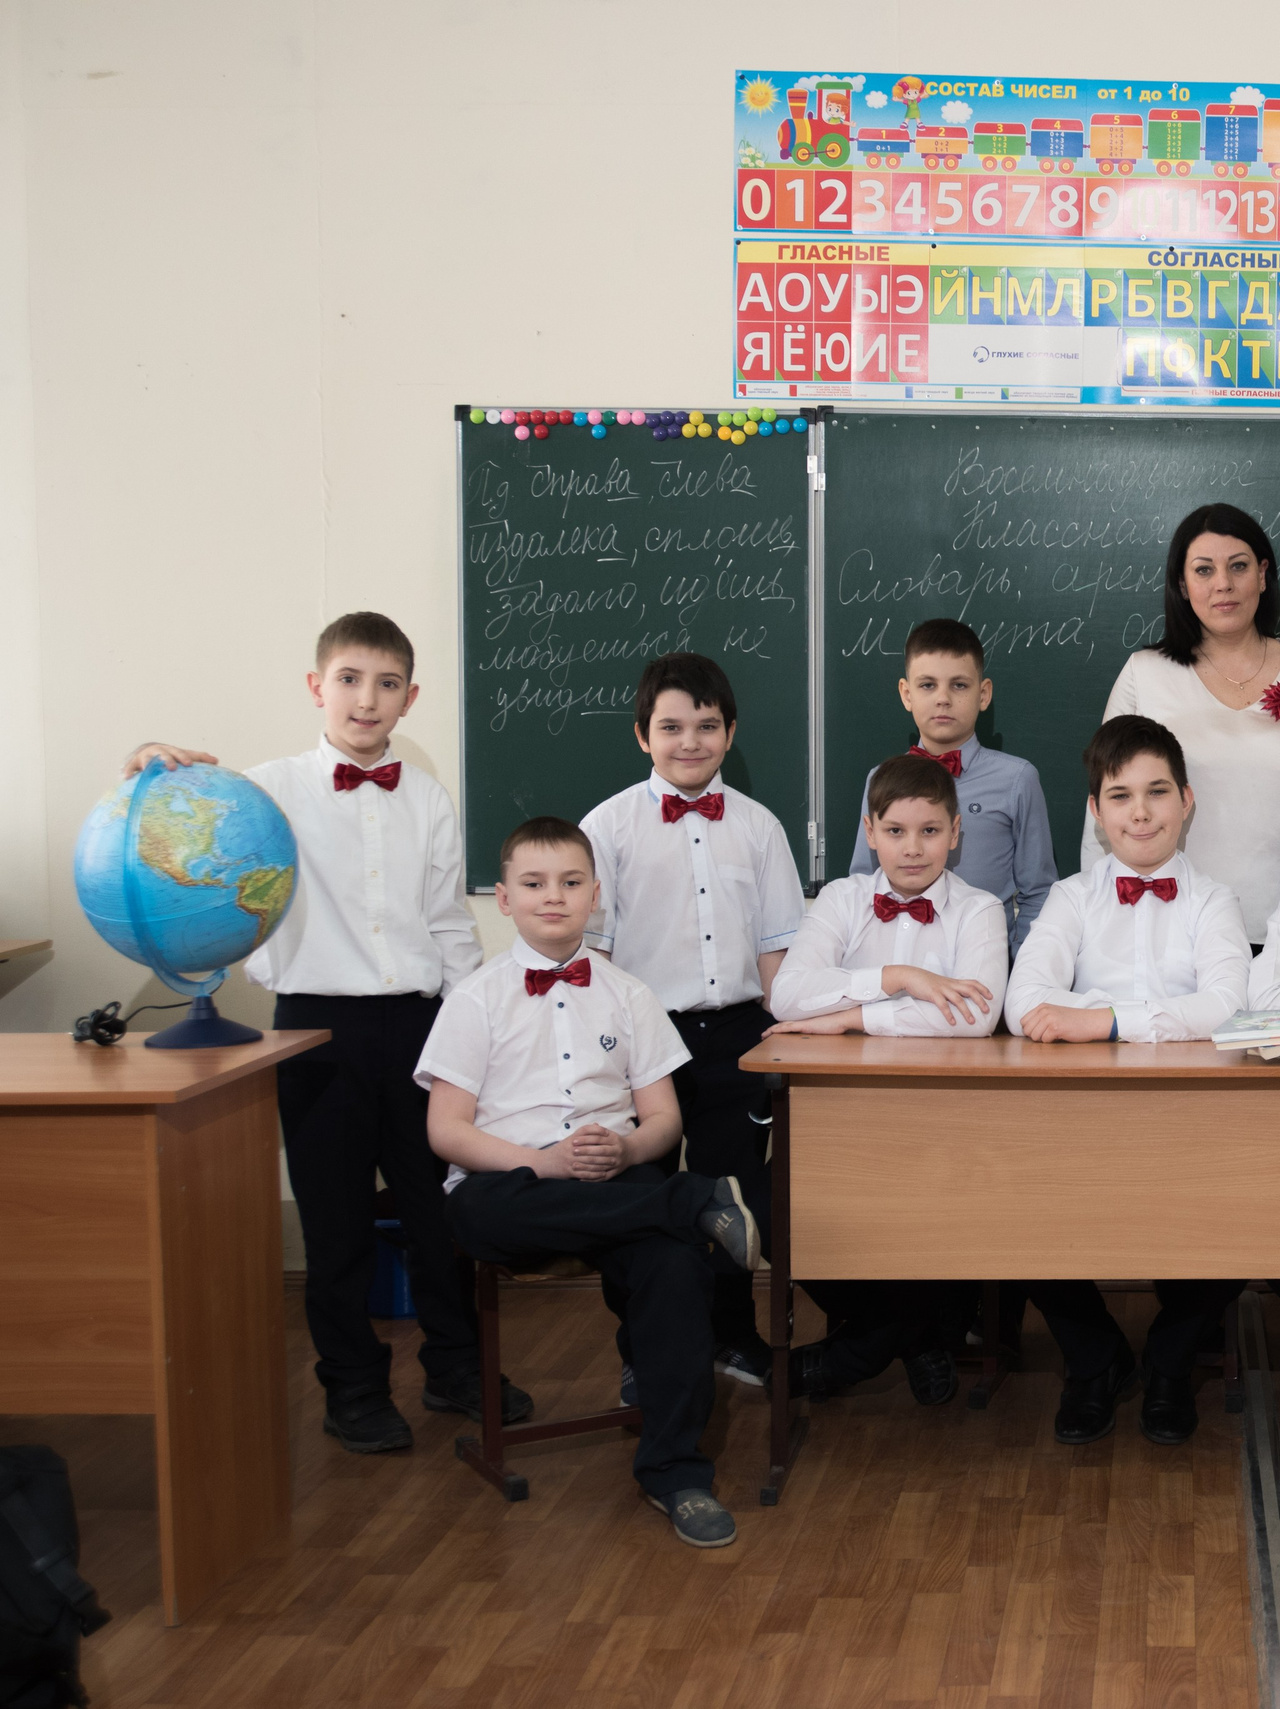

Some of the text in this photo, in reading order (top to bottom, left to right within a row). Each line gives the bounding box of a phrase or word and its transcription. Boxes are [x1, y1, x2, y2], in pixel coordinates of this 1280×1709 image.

[925, 81, 1190, 102] СОСТАВ ЧИСЕЛ от 1 до 10
[1228, 105, 1236, 115] 7
[1113, 115, 1120, 124] 5
[1171, 111, 1178, 120] 6
[996, 123, 1004, 133] 3
[1053, 121, 1061, 130] 4
[880, 130, 886, 139] 1
[938, 127, 946, 137] 2
[742, 178, 771, 222] 0
[786, 179, 804, 222] 1
[819, 179, 847, 223] 2
[857, 179, 886, 223] 3
[894, 182, 926, 225] 4
[935, 182, 963, 226] 5
[972, 183, 1002, 226] 6
[1012, 185, 1041, 227] 7
[1049, 185, 1079, 228] 8
[1089, 186, 1119, 229] 9
[1124, 187, 1161, 230] 10
[1166, 188, 1197, 232] 11
[1203, 190, 1238, 232] 12
[1241, 190, 1276, 233] 13
[777, 244, 890, 262] ГЛАСНЫЕ
[724, 626, 771, 659] не
